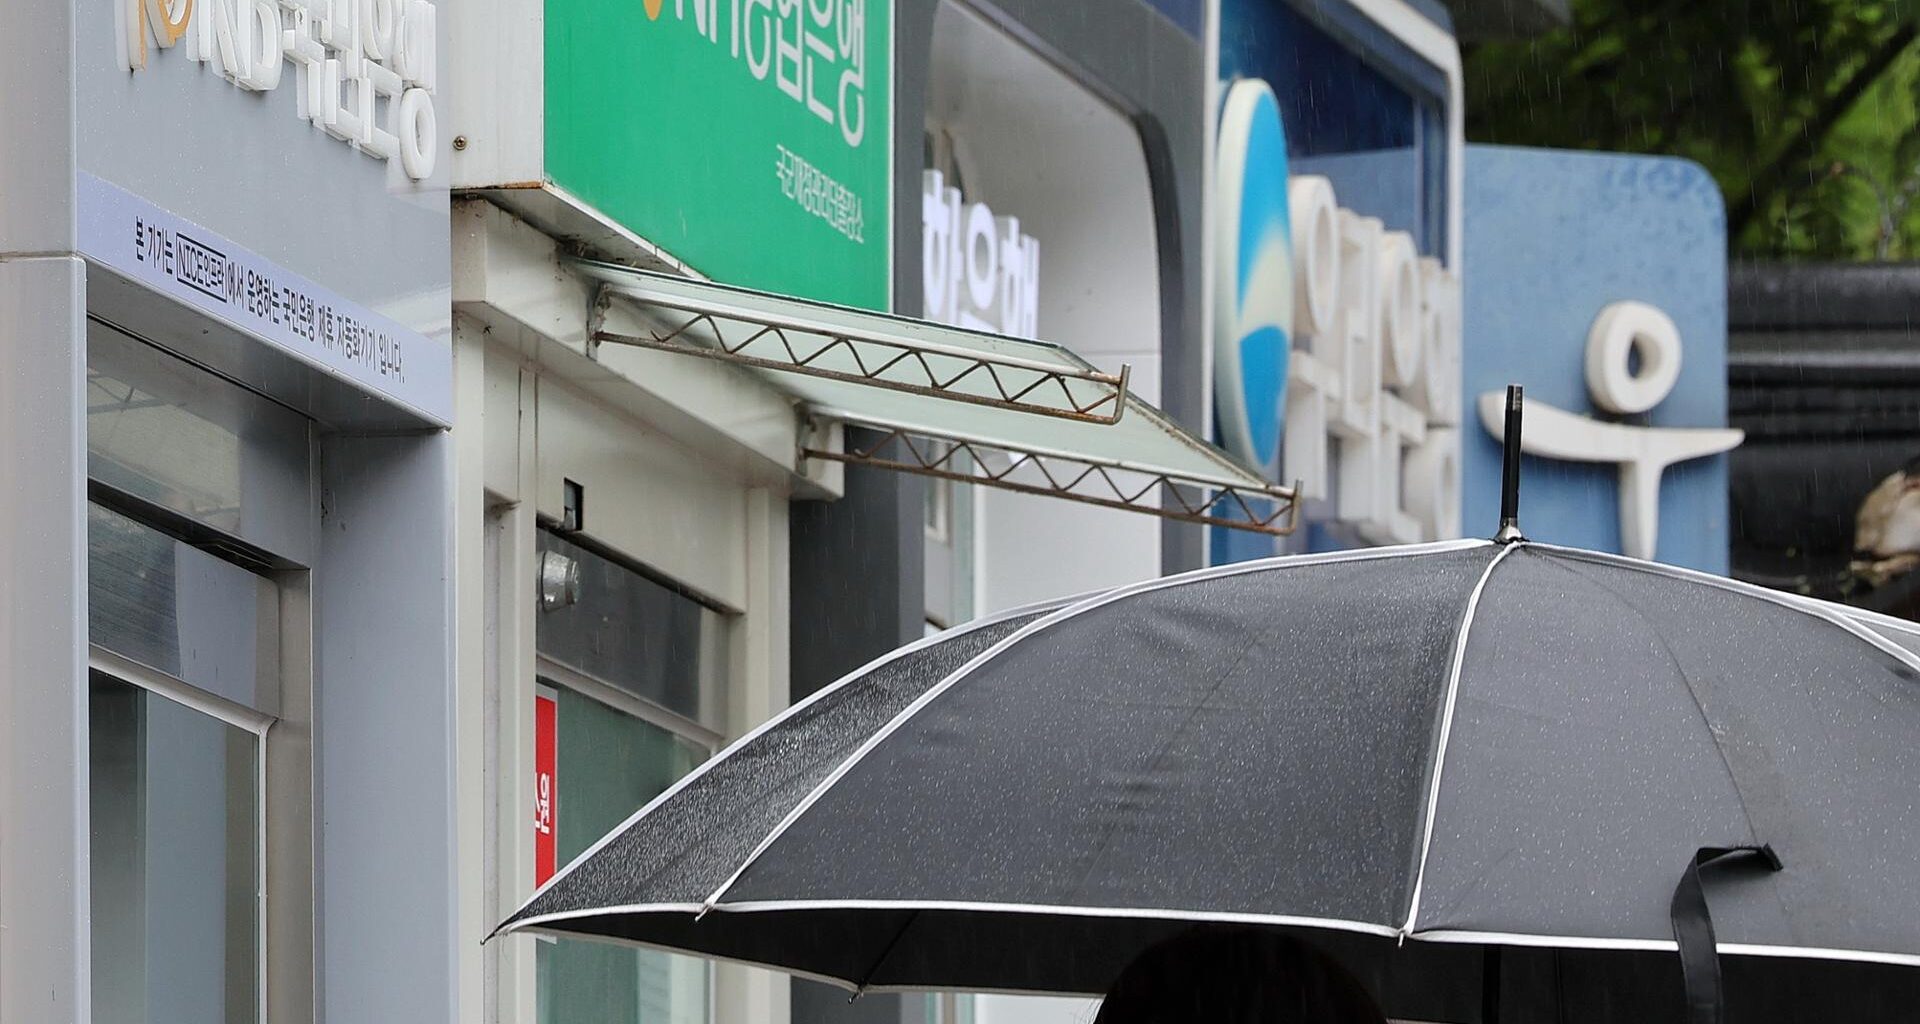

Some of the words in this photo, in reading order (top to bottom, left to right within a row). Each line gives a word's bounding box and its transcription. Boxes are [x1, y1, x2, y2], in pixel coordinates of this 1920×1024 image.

[136, 216, 144, 262] 본
[147, 224, 173, 275] 기기는
[247, 269, 280, 325] 운영하는
[283, 287, 315, 342] 국민은행
[318, 304, 334, 351] 제휴
[337, 313, 377, 371] 자동화기기
[1478, 300, 1746, 562] 우
